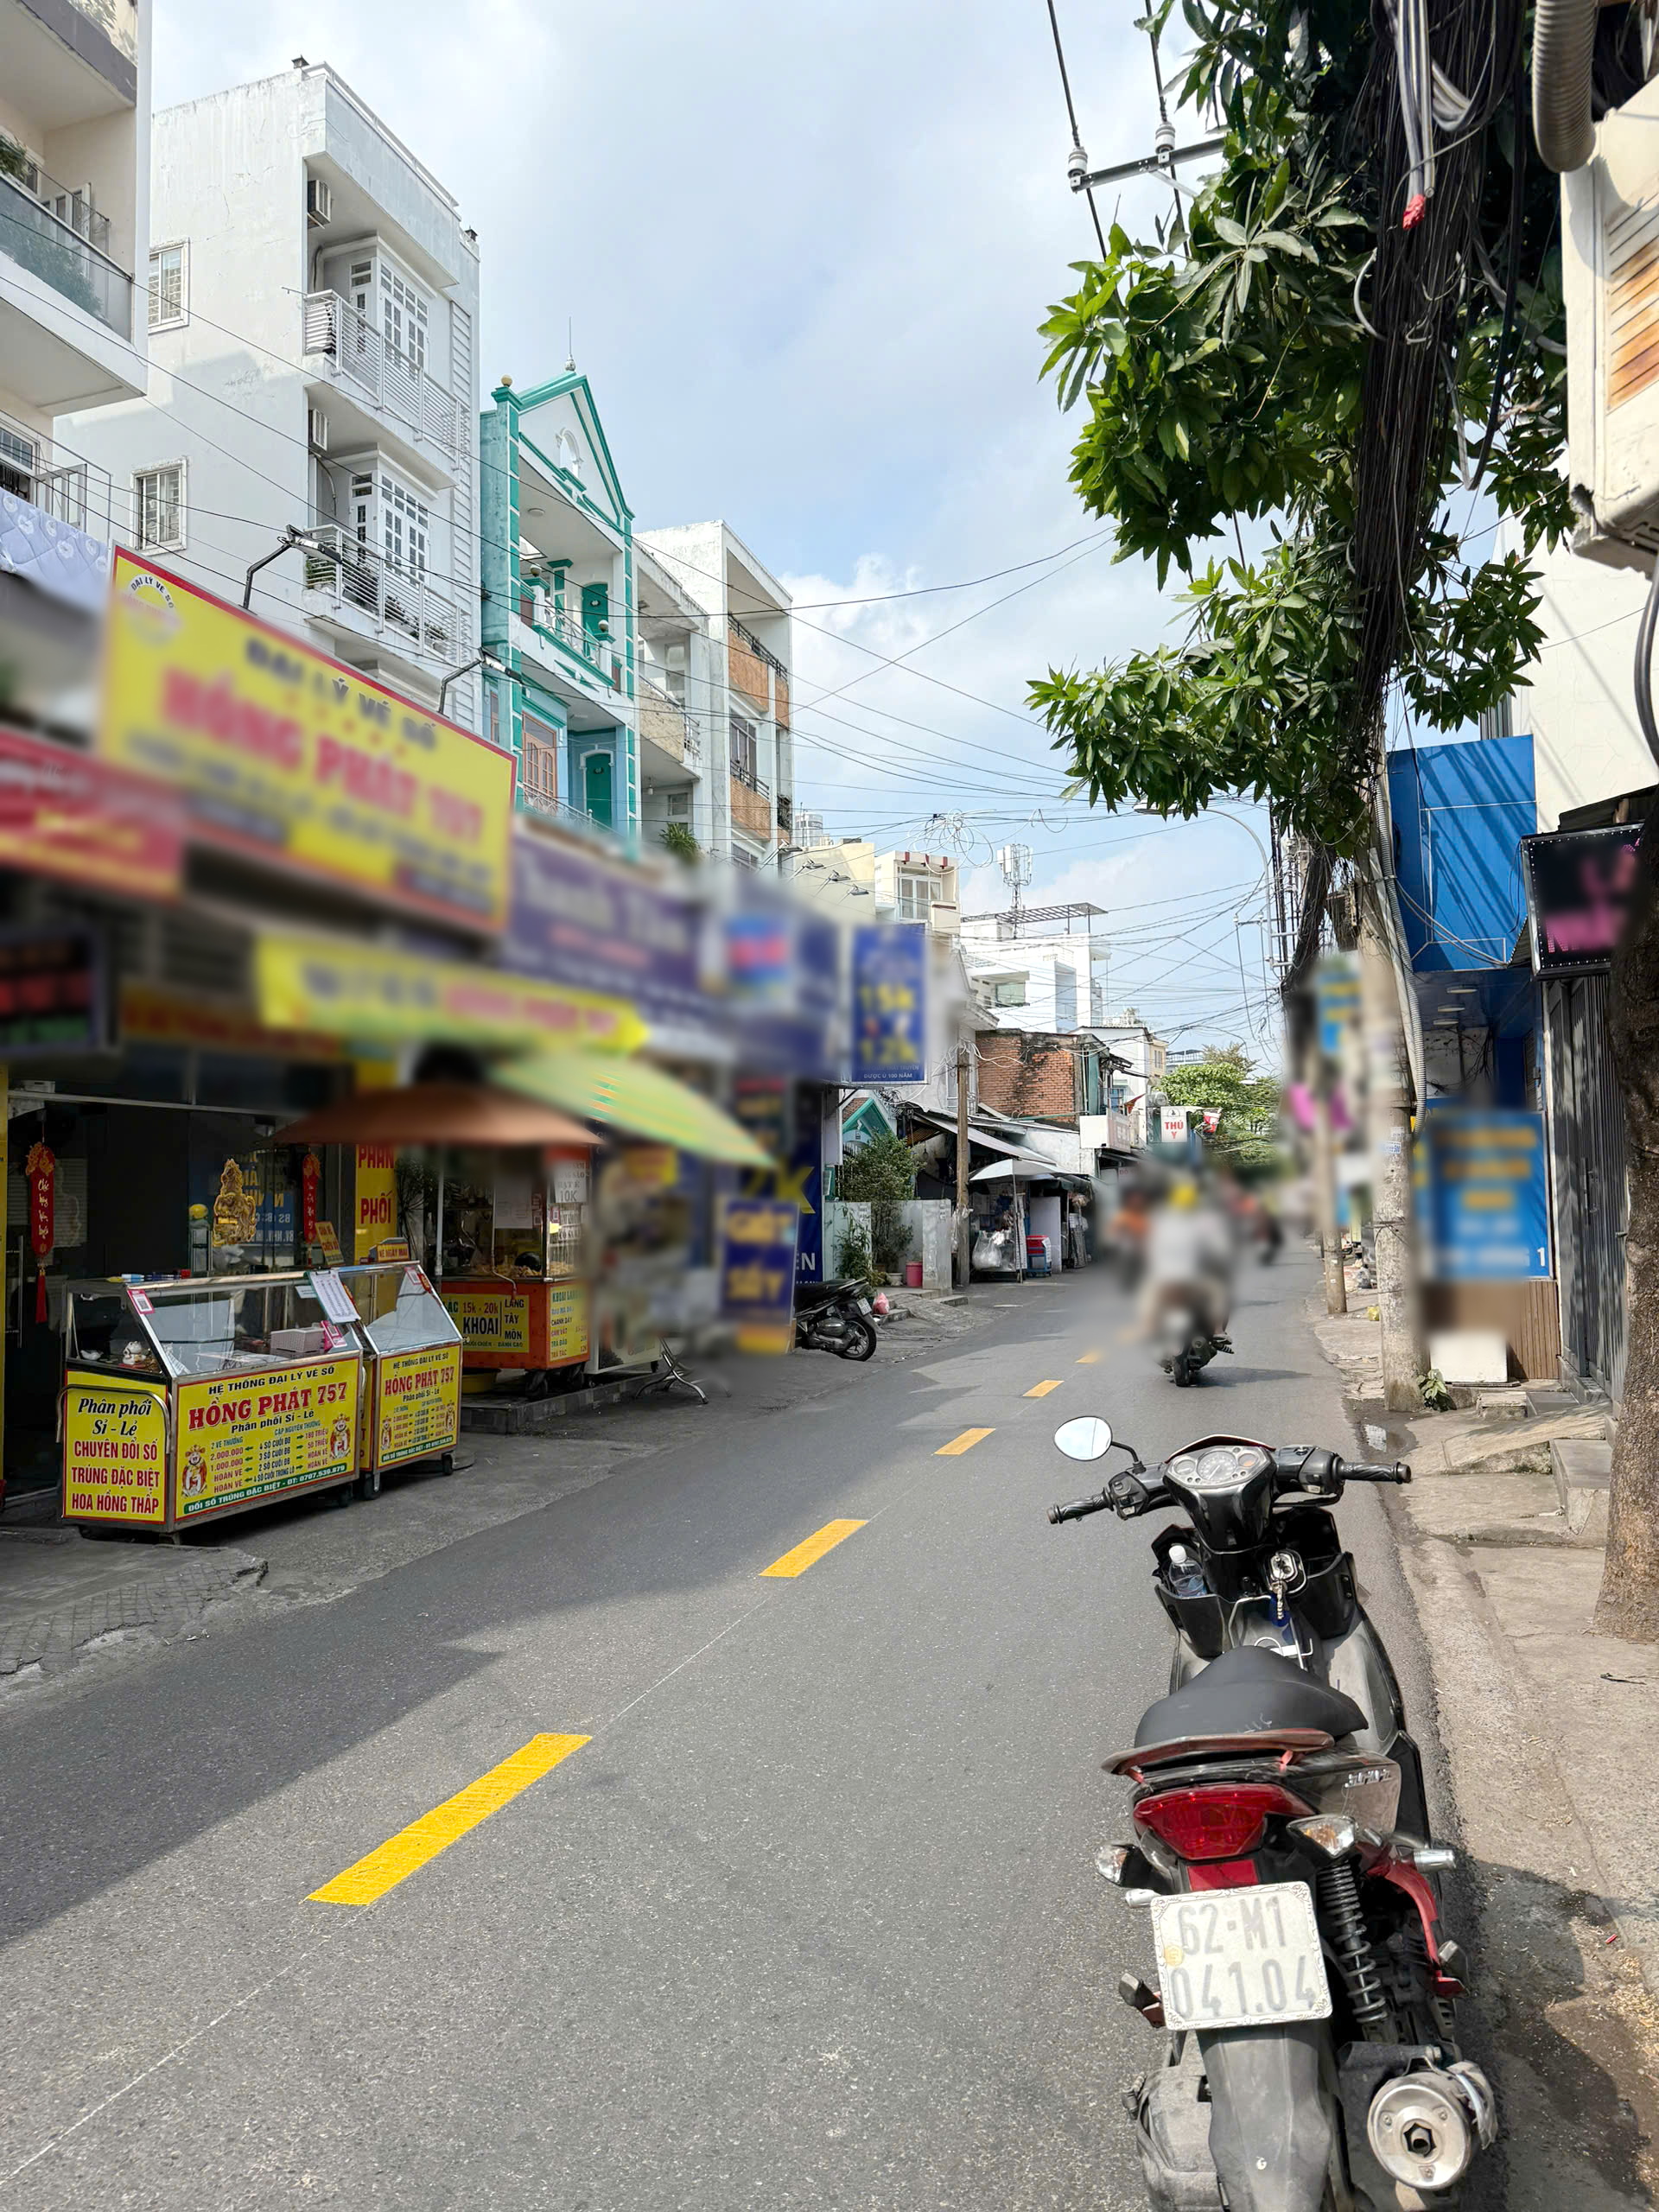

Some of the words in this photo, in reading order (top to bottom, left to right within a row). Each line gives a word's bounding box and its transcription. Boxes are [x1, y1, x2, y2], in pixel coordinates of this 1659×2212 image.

[1165, 1120, 1184, 1130] THÚ
[360, 1191, 392, 1224] PHỐI
[505, 1299, 524, 1308] LANG
[463, 1317, 499, 1335] KHOAI
[385, 1372, 412, 1395] HỒNG
[415, 1368, 438, 1389] PHÁT
[441, 1367, 454, 1383] 757
[78, 1398, 116, 1414] Phân
[118, 1399, 152, 1418] phối
[188, 1396, 251, 1430] HỒNG
[257, 1386, 312, 1416] PHÁT
[317, 1382, 347, 1405] 757
[231, 1420, 257, 1433] Phân
[74, 1439, 118, 1459] CHUYÊN
[122, 1437, 139, 1459] ĐỔI
[143, 1438, 158, 1460] SỐ
[72, 1464, 108, 1484] TRÚNG
[111, 1465, 133, 1489] ĐẶC
[137, 1467, 160, 1491] BIỆT
[72, 1493, 92, 1510] HOA
[97, 1490, 127, 1512] HỒNG
[131, 1491, 159, 1514] THẤP
[1170, 1955, 1316, 2019] 041.04
